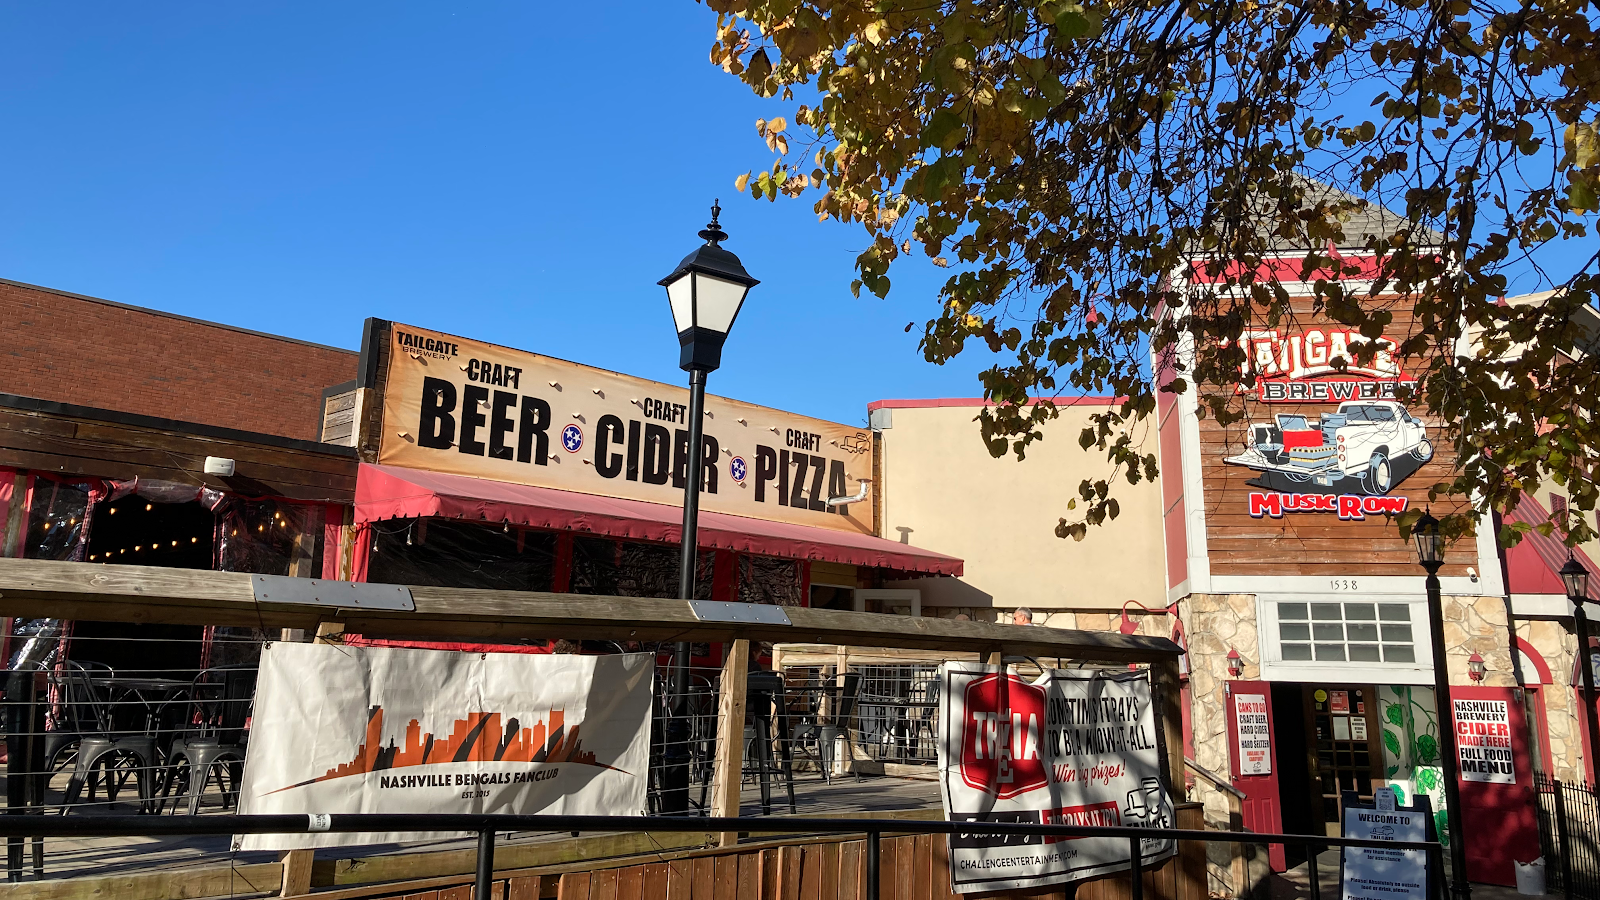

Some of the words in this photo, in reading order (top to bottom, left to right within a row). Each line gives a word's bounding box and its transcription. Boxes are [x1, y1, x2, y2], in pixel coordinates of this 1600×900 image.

[396, 331, 459, 356] TAILGATE
[402, 346, 451, 361] BREWERY
[467, 358, 522, 390] CRAFT
[643, 397, 687, 425] CRAFT
[417, 376, 552, 467] BEER
[785, 428, 821, 452] CRAFT
[594, 414, 720, 494] CIDER
[754, 444, 849, 516] PIZZA
[1249, 493, 1337, 517] MUSIC
[1338, 496, 1408, 520] ROW
[1330, 580, 1358, 591] 1538
[1238, 702, 1252, 713] CANS
[1252, 702, 1259, 713] TO
[1260, 702, 1266, 712] GO
[1454, 701, 1505, 712] NASHVILLE
[1239, 714, 1254, 724] CRAFT
[1456, 712, 1506, 721] BREWERY
[1240, 725, 1253, 735] HARD
[1457, 721, 1509, 736] CIDER
[1241, 739, 1253, 749] HARD
[1254, 739, 1270, 748] SELTZER
[1458, 735, 1485, 747] MADE
[1486, 736, 1510, 748] HERE
[1460, 748, 1482, 760] FULL
[1484, 748, 1511, 761] FOOD
[1052, 763, 1075, 783] Win
[1078, 762, 1089, 787] ig
[1091, 759, 1126, 785] prizes!
[1461, 760, 1513, 774] MENU
[380, 774, 451, 789] NASHVILLE
[455, 772, 510, 786] BENGALS
[513, 768, 559, 783] FANCLUB
[461, 791, 475, 799] EST.
[475, 790, 490, 799] 2015
[1358, 813, 1398, 825] WELCOME
[1399, 816, 1410, 825] TO
